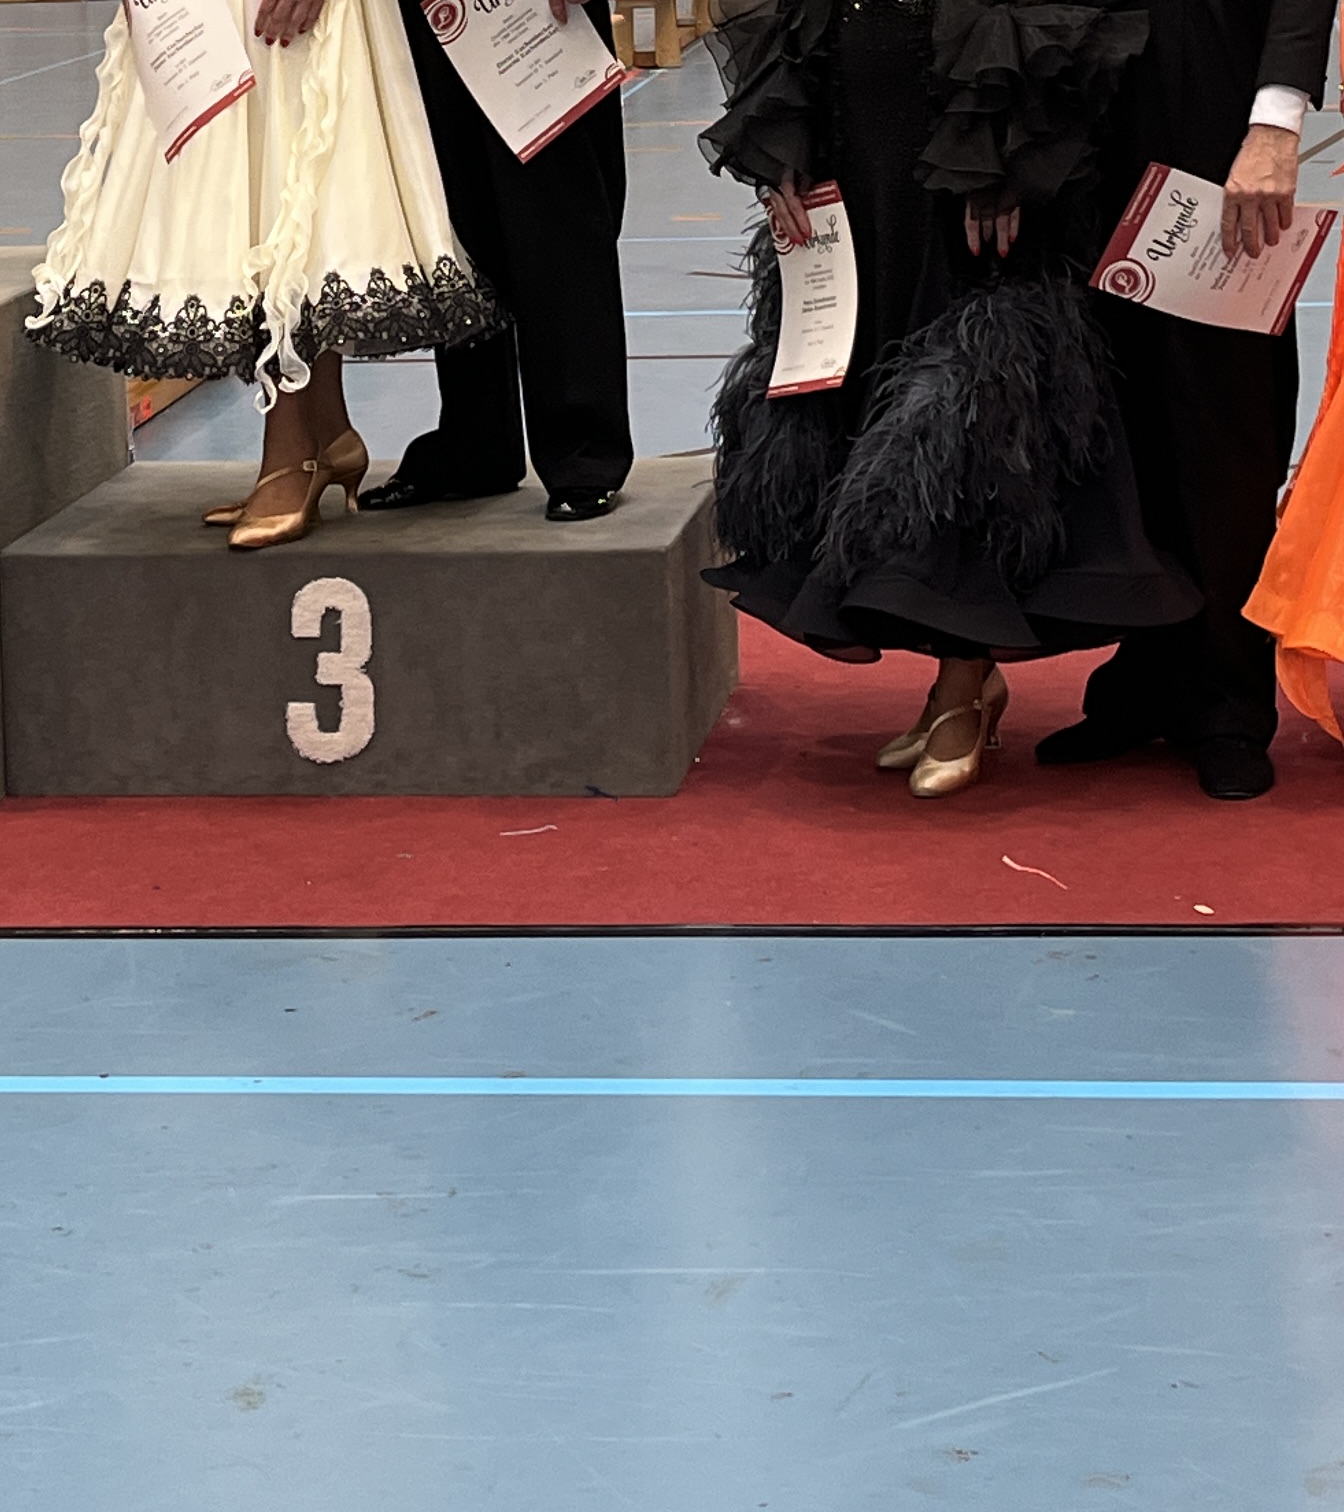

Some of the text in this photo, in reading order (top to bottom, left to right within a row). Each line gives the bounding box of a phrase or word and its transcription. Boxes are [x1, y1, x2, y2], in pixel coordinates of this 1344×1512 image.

[805, 214, 840, 254] rkunde
[1146, 189, 1199, 261] Urkunde
[285, 575, 376, 764] 3
